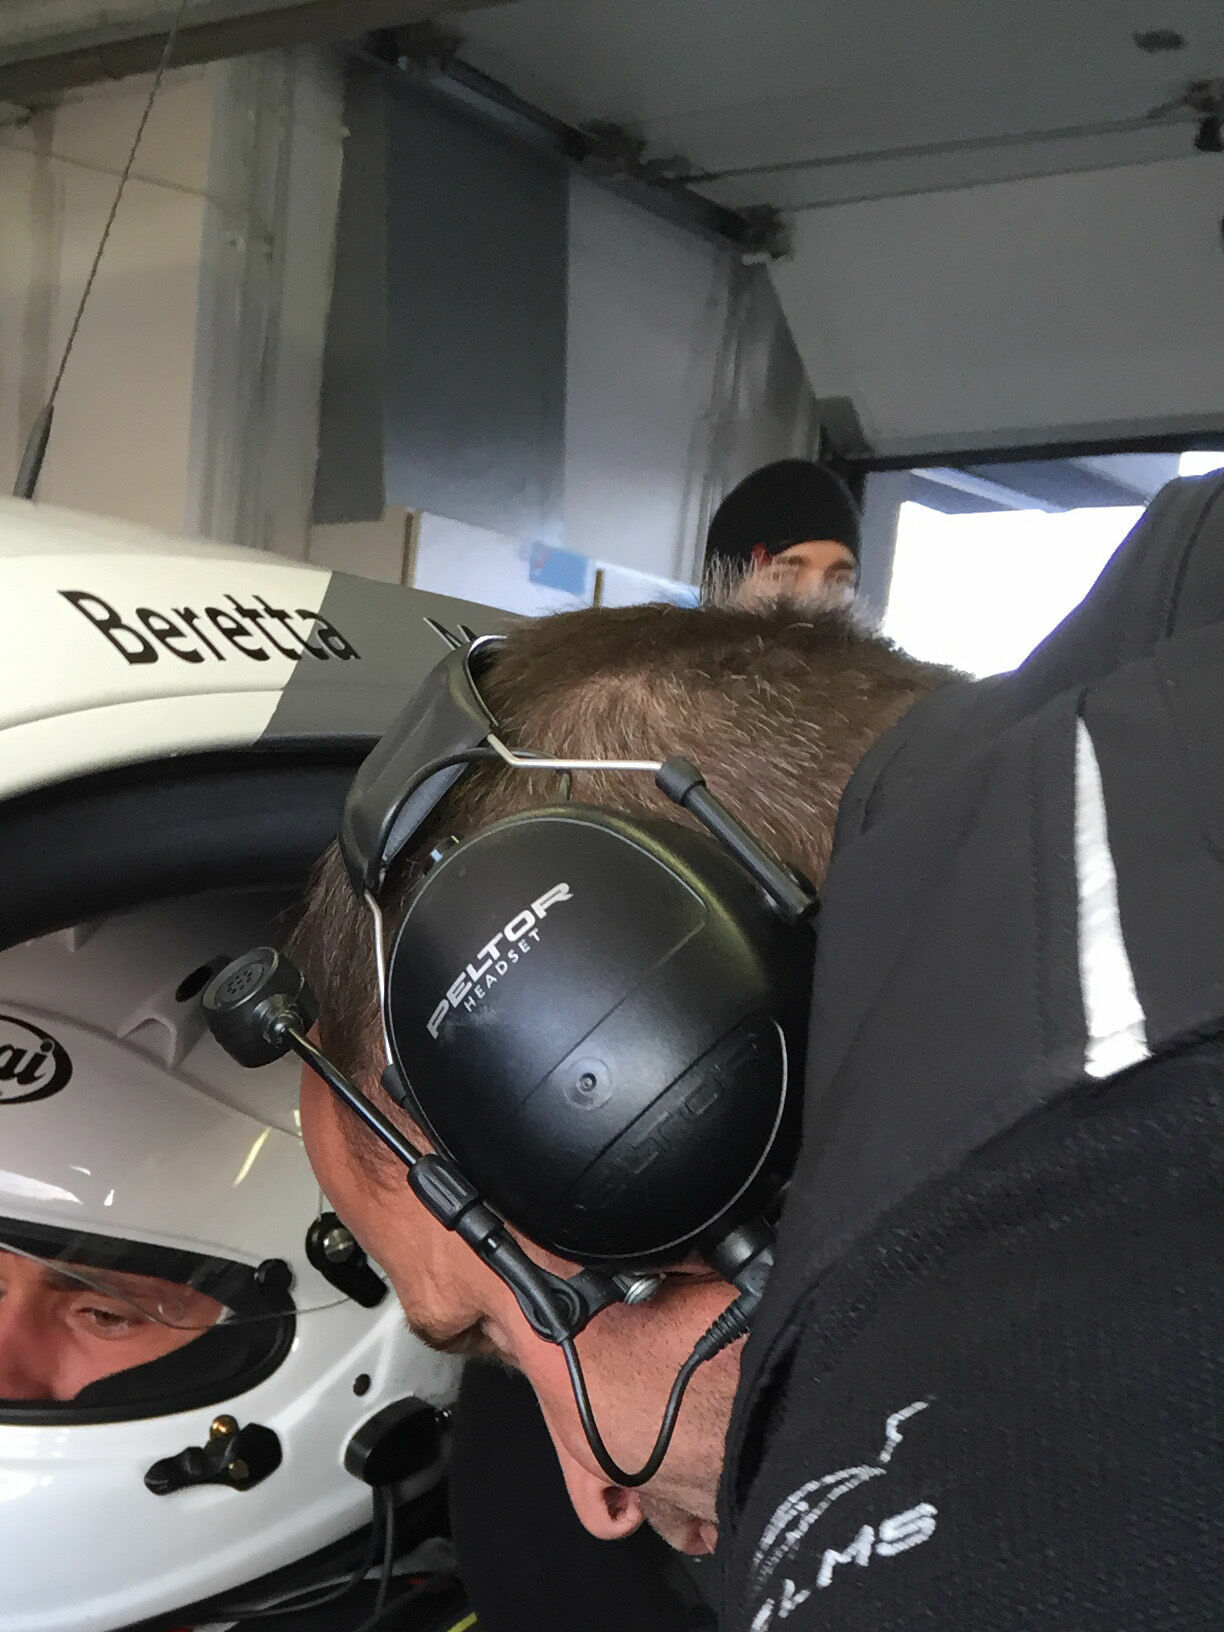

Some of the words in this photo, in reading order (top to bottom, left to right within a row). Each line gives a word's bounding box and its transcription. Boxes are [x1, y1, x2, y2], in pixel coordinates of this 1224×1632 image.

[57, 589, 362, 666] Beretta
[426, 881, 575, 1040] PELTOR
[463, 927, 542, 1013] HEADSET
